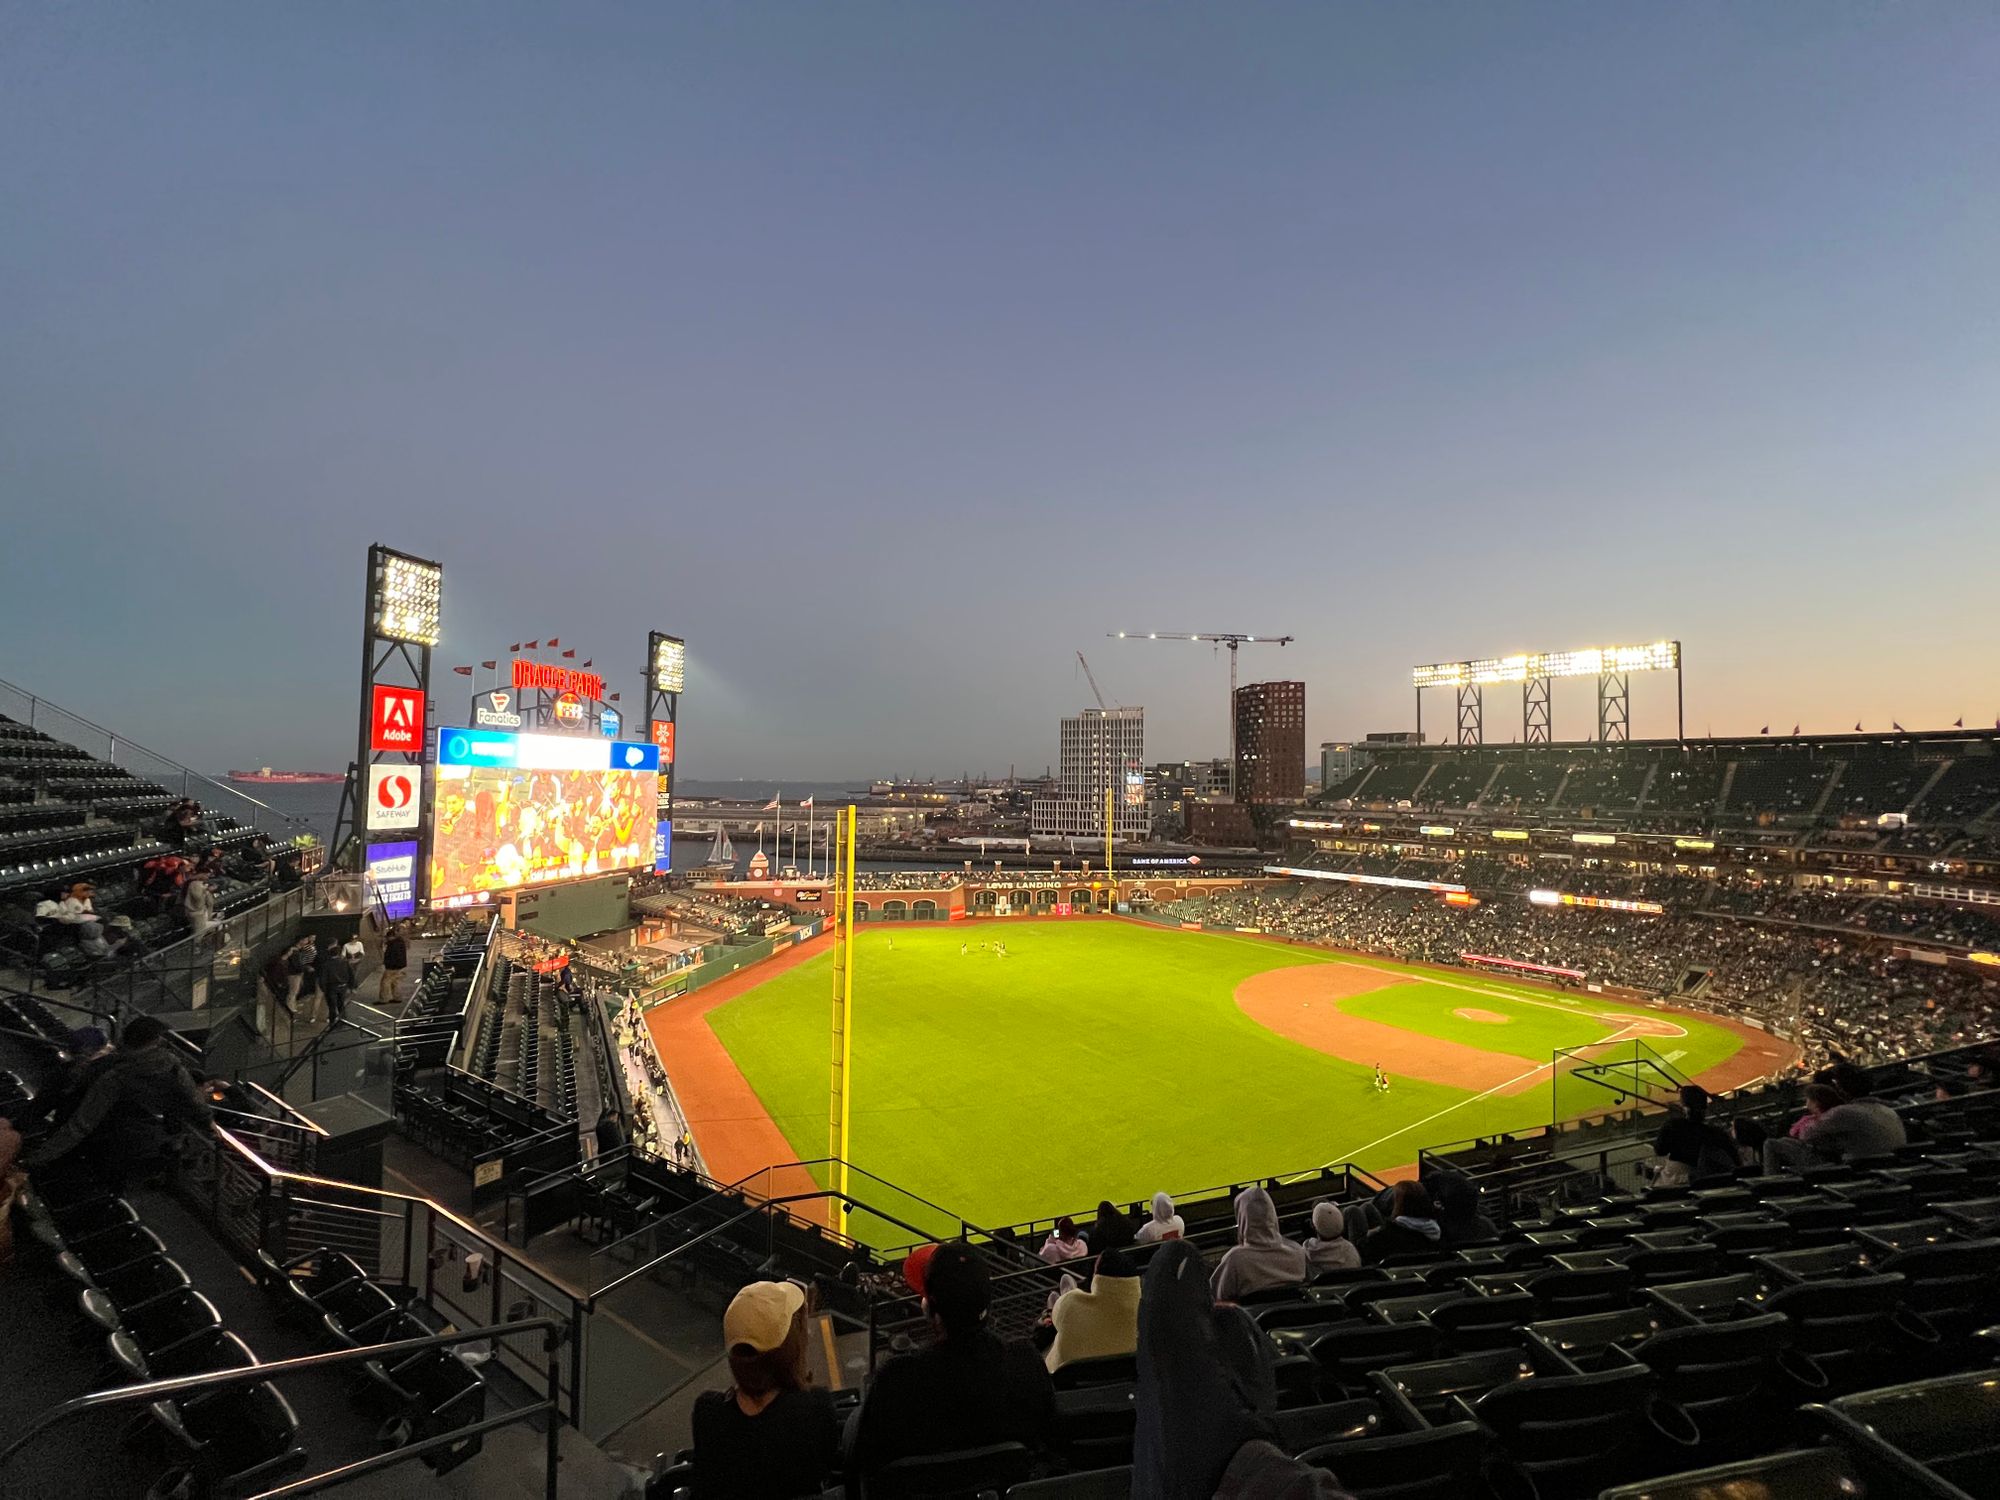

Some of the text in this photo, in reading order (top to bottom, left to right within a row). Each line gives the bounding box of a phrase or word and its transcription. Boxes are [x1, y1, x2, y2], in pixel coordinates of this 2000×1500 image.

[512, 660, 603, 701] ORACLE PARK
[477, 709, 521, 726] Fanatics
[383, 729, 412, 741] Adobe
[376, 809, 410, 819] SAFEWAY
[375, 863, 407, 874] StubHub
[1016, 881, 1061, 889] LANDING
[800, 925, 812, 941] VISA
